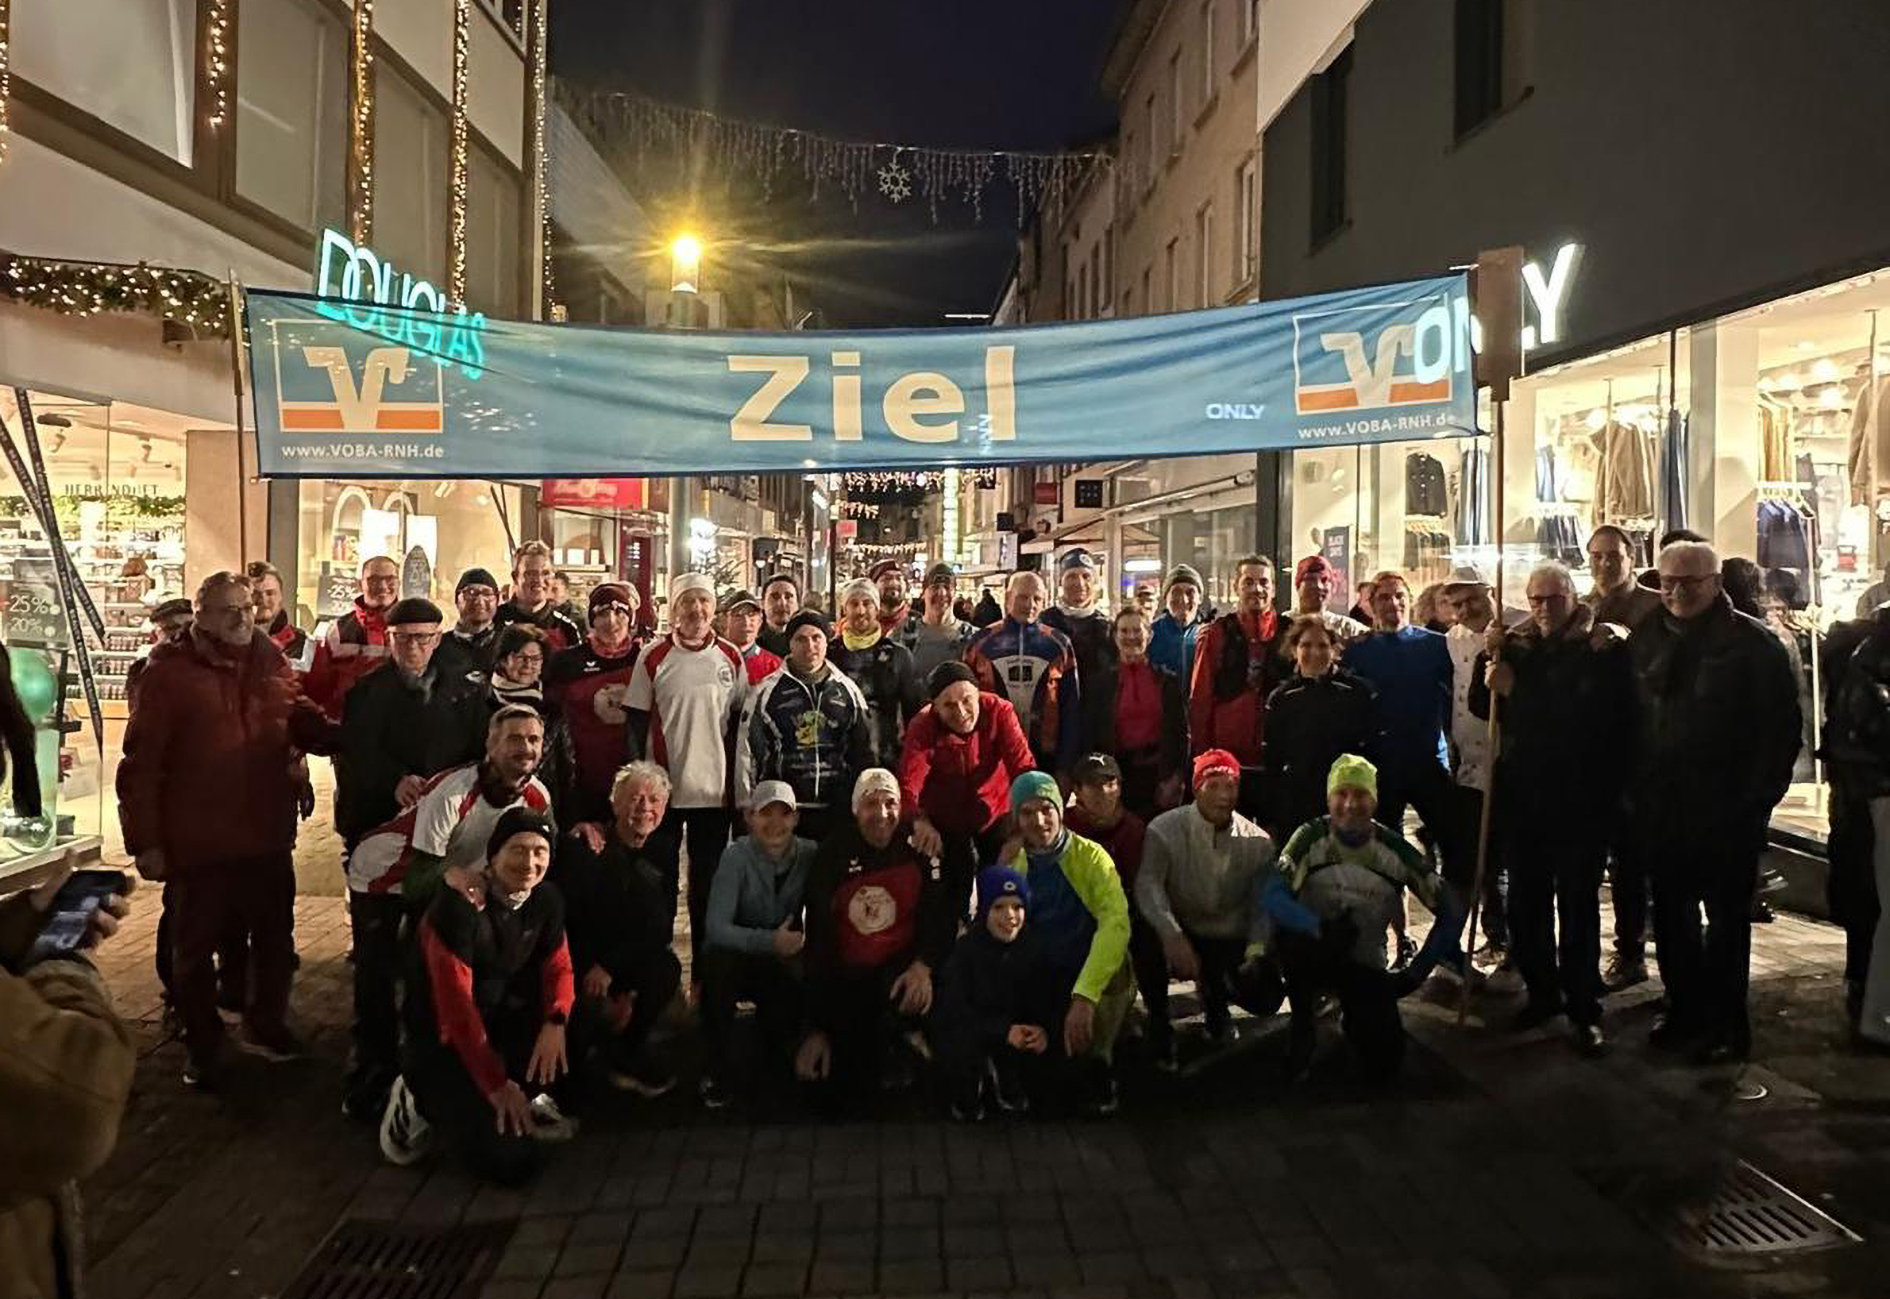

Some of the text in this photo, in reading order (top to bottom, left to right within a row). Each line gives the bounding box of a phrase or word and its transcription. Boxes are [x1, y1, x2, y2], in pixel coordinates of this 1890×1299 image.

[1414, 243, 1582, 384] ONY
[728, 346, 1016, 443] Ziel
[1206, 403, 1265, 420] ONLY
[1297, 412, 1458, 440] www.VOBA-RNH.de
[281, 443, 445, 458] www.VOBA-RNH.de
[9, 595, 49, 614] 25%
